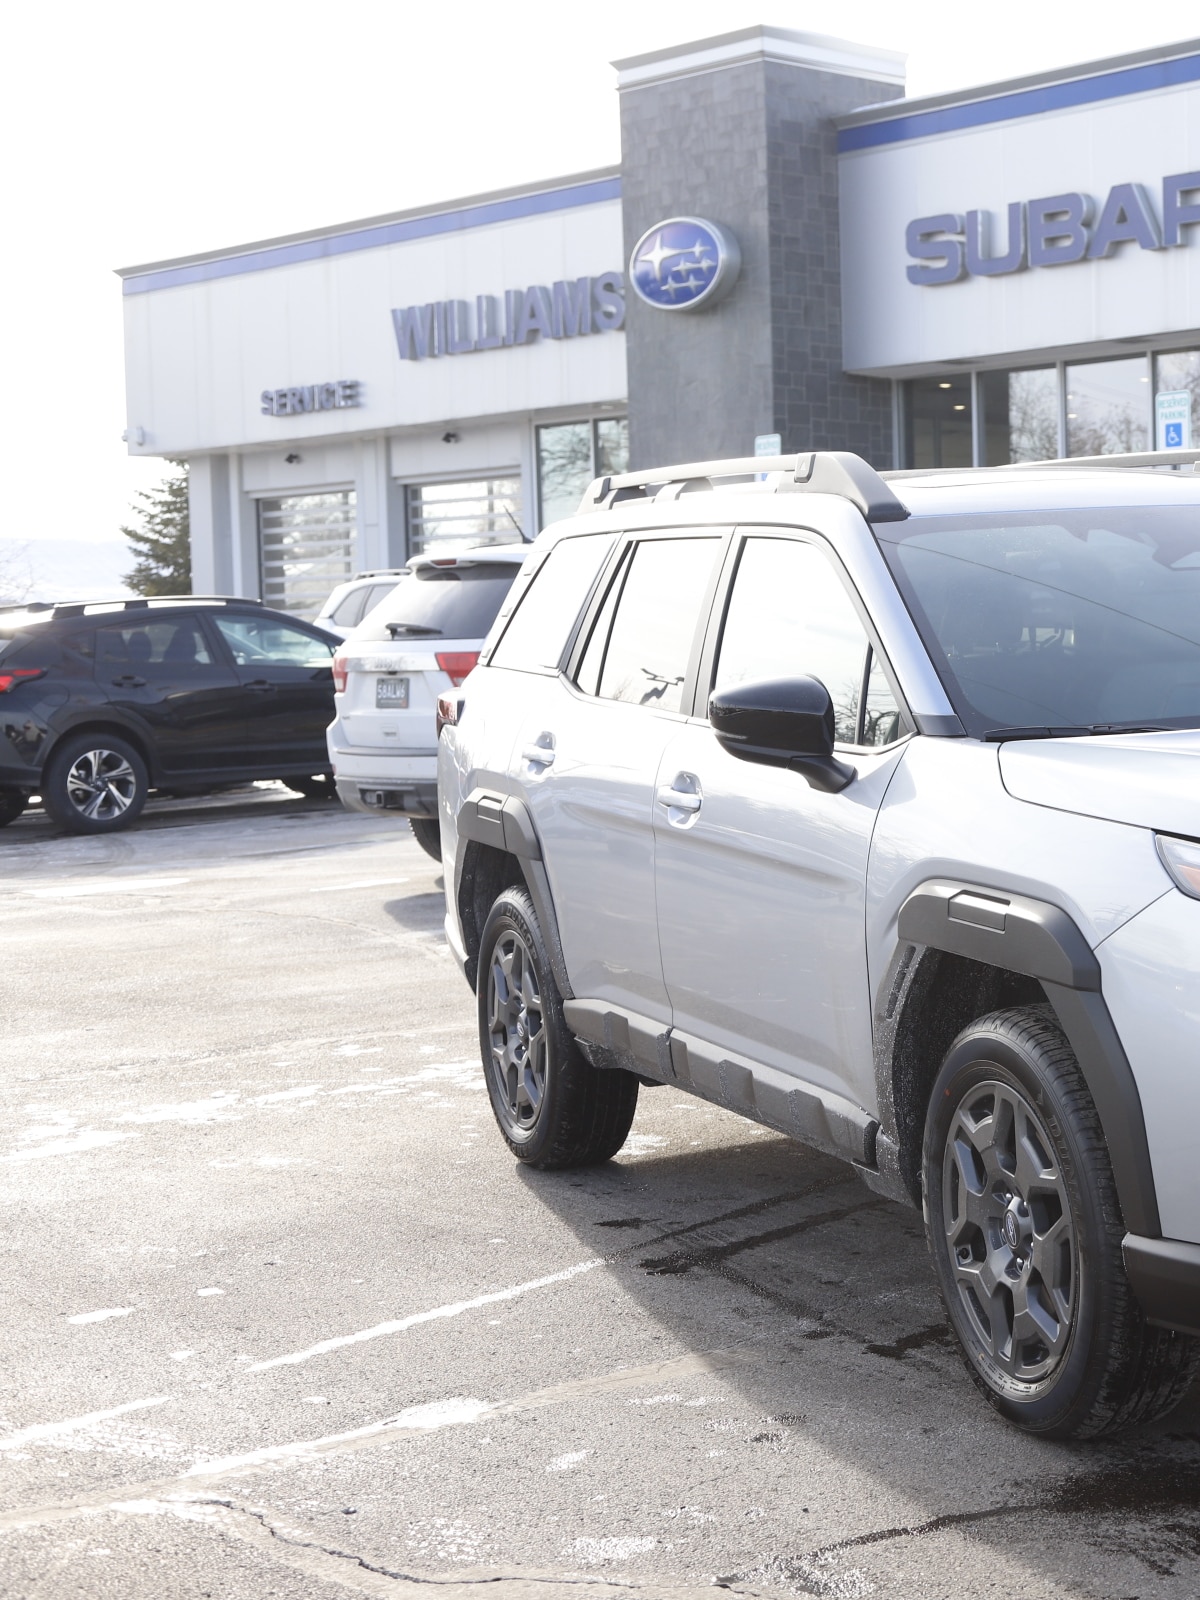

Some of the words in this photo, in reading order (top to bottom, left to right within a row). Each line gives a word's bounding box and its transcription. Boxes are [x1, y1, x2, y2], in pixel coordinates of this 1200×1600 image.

[390, 271, 626, 361] WILLIAMS
[261, 380, 362, 416] SERVICE
[1160, 410, 1186, 420] PARKING
[506, 904, 537, 960] DUNLOP
